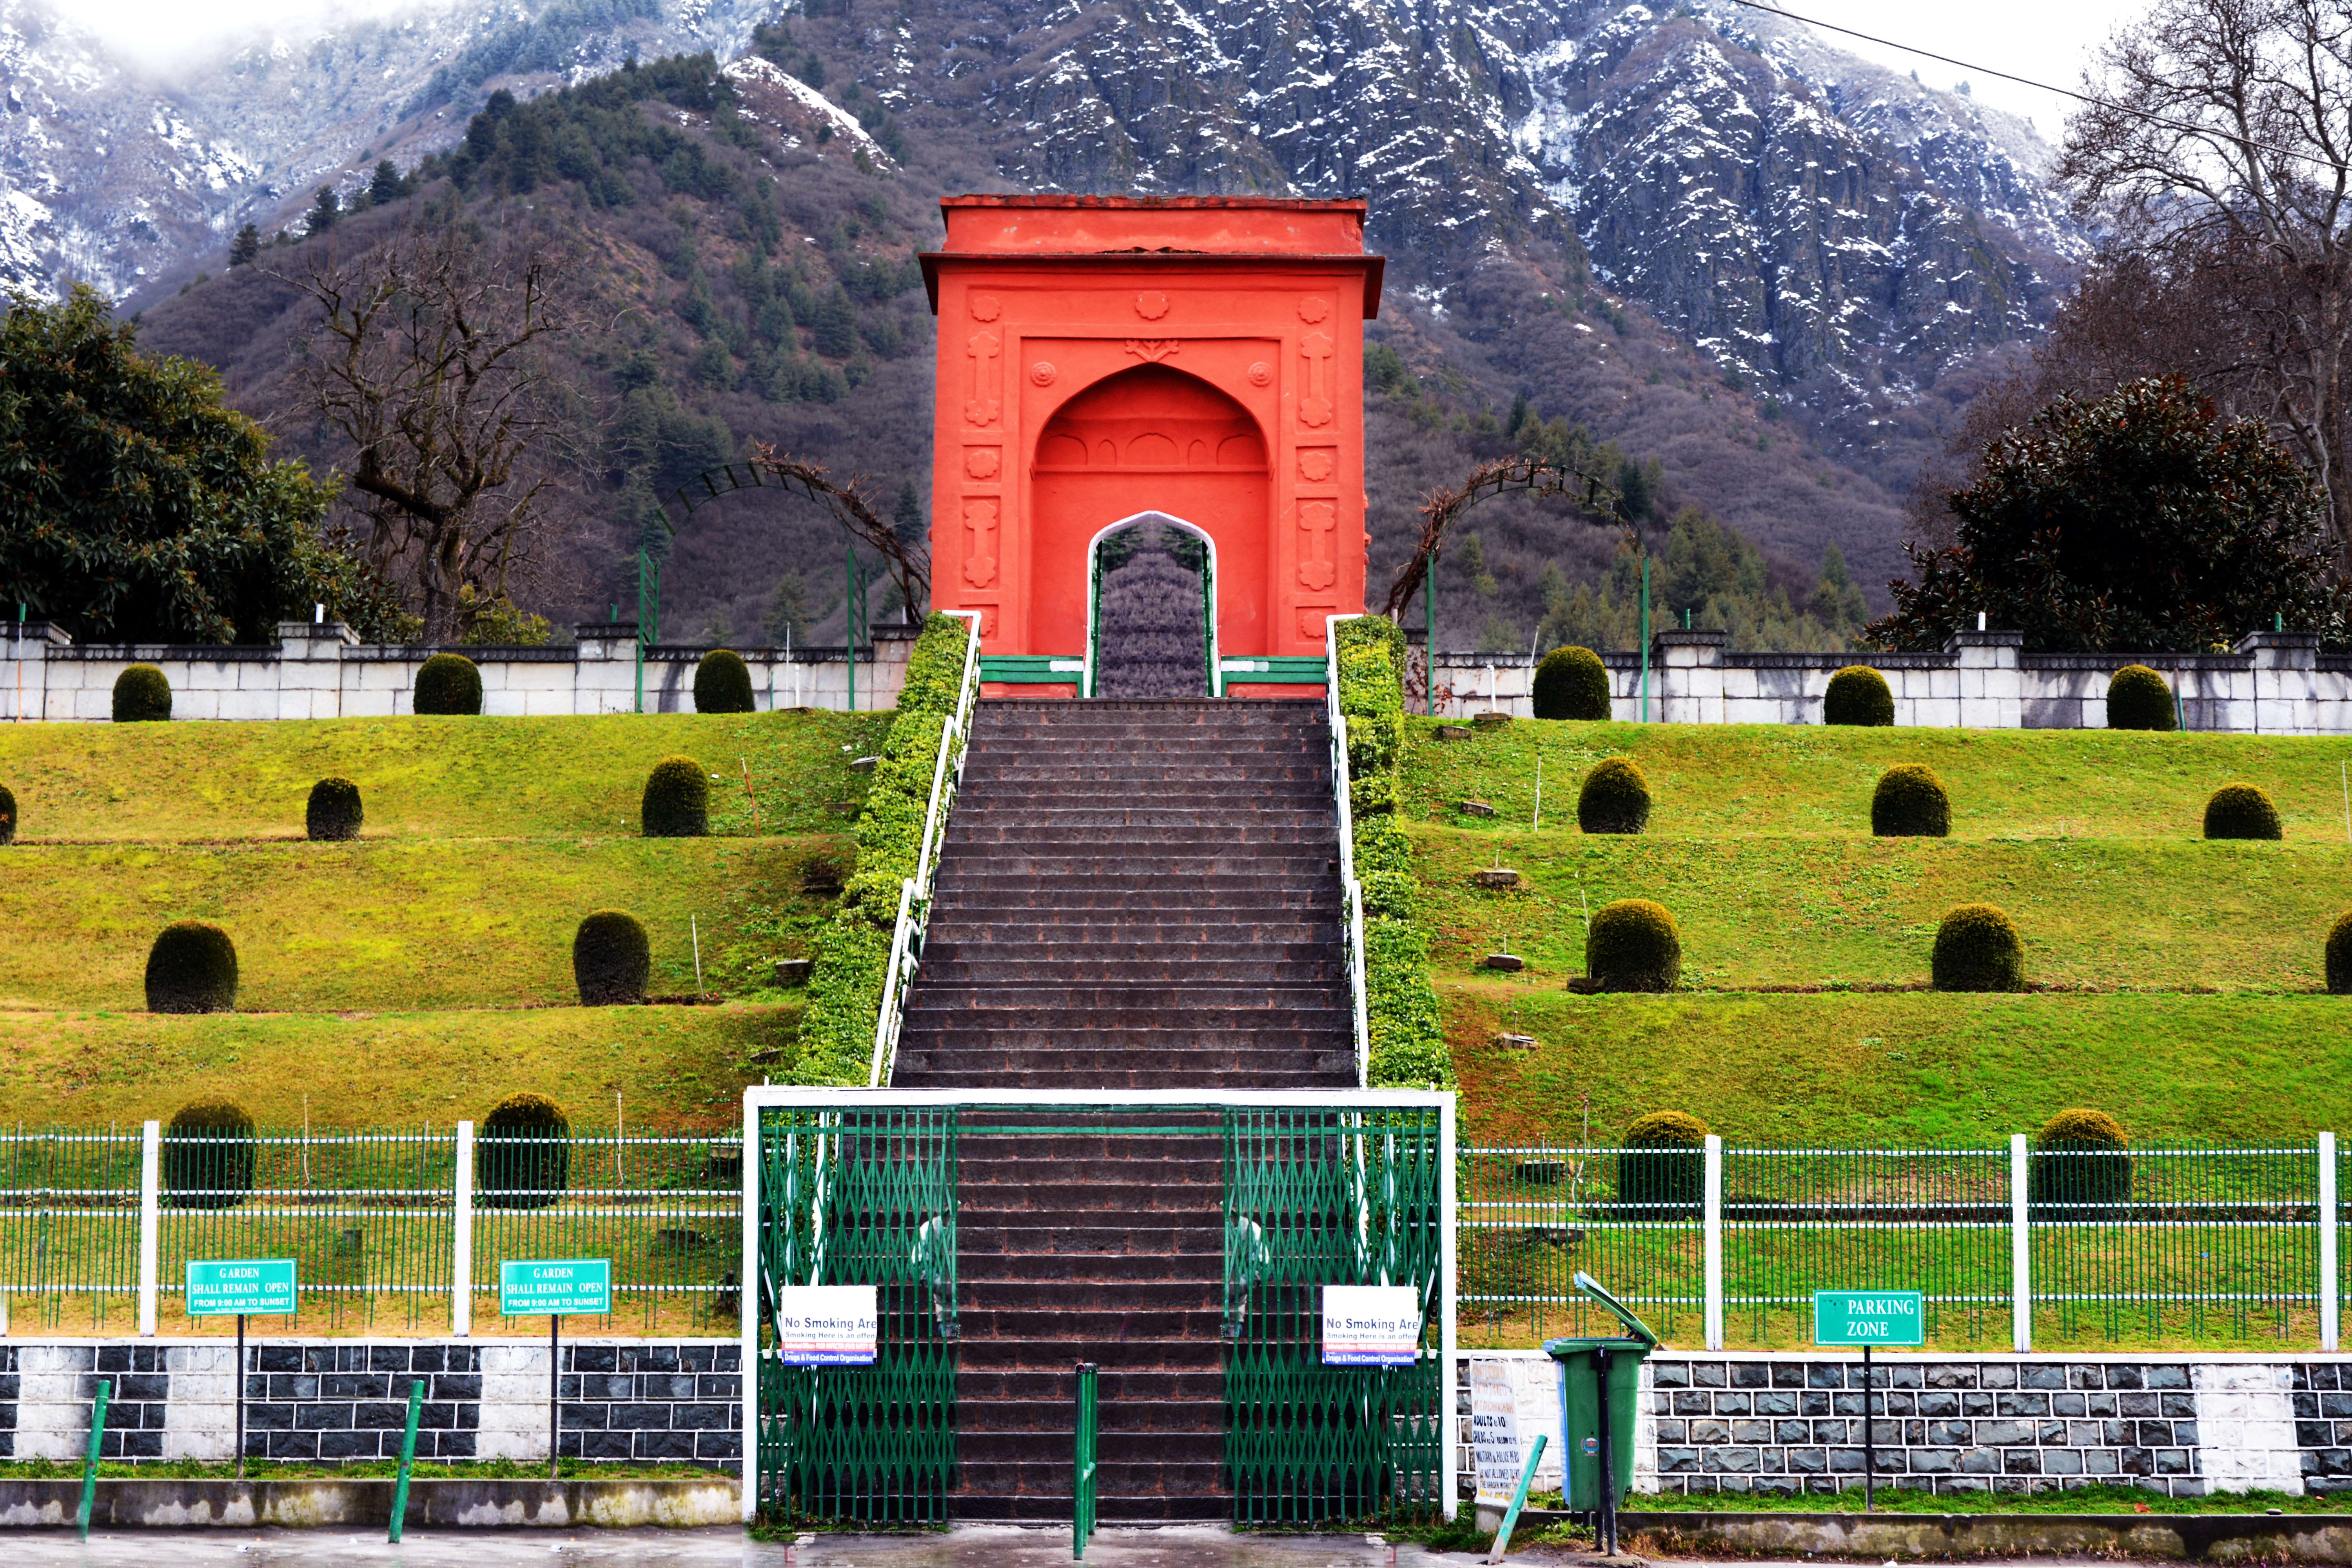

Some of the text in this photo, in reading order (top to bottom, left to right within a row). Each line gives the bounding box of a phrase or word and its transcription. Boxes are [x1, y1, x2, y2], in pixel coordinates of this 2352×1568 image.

[192, 1282, 289, 1294] SHALL REMAIN OPEN
[506, 1282, 603, 1294] SHALL REMAIN OPEN
[1848, 1299, 1914, 1315] PARKING
[785, 1318, 800, 1327] No
[805, 1318, 853, 1331] Smoking
[1327, 1318, 1341, 1328] No
[1346, 1318, 1394, 1332] Smoking
[1847, 1321, 1889, 1336] ZONE
[784, 1353, 800, 1362] Drugs
[840, 1354, 872, 1363] Organisation
[1326, 1354, 1341, 1363] Drugs
[1381, 1355, 1414, 1364] Organisation
[1474, 1415, 1492, 1426] ADULTS
[1476, 1451, 1492, 1463] MILITARY
